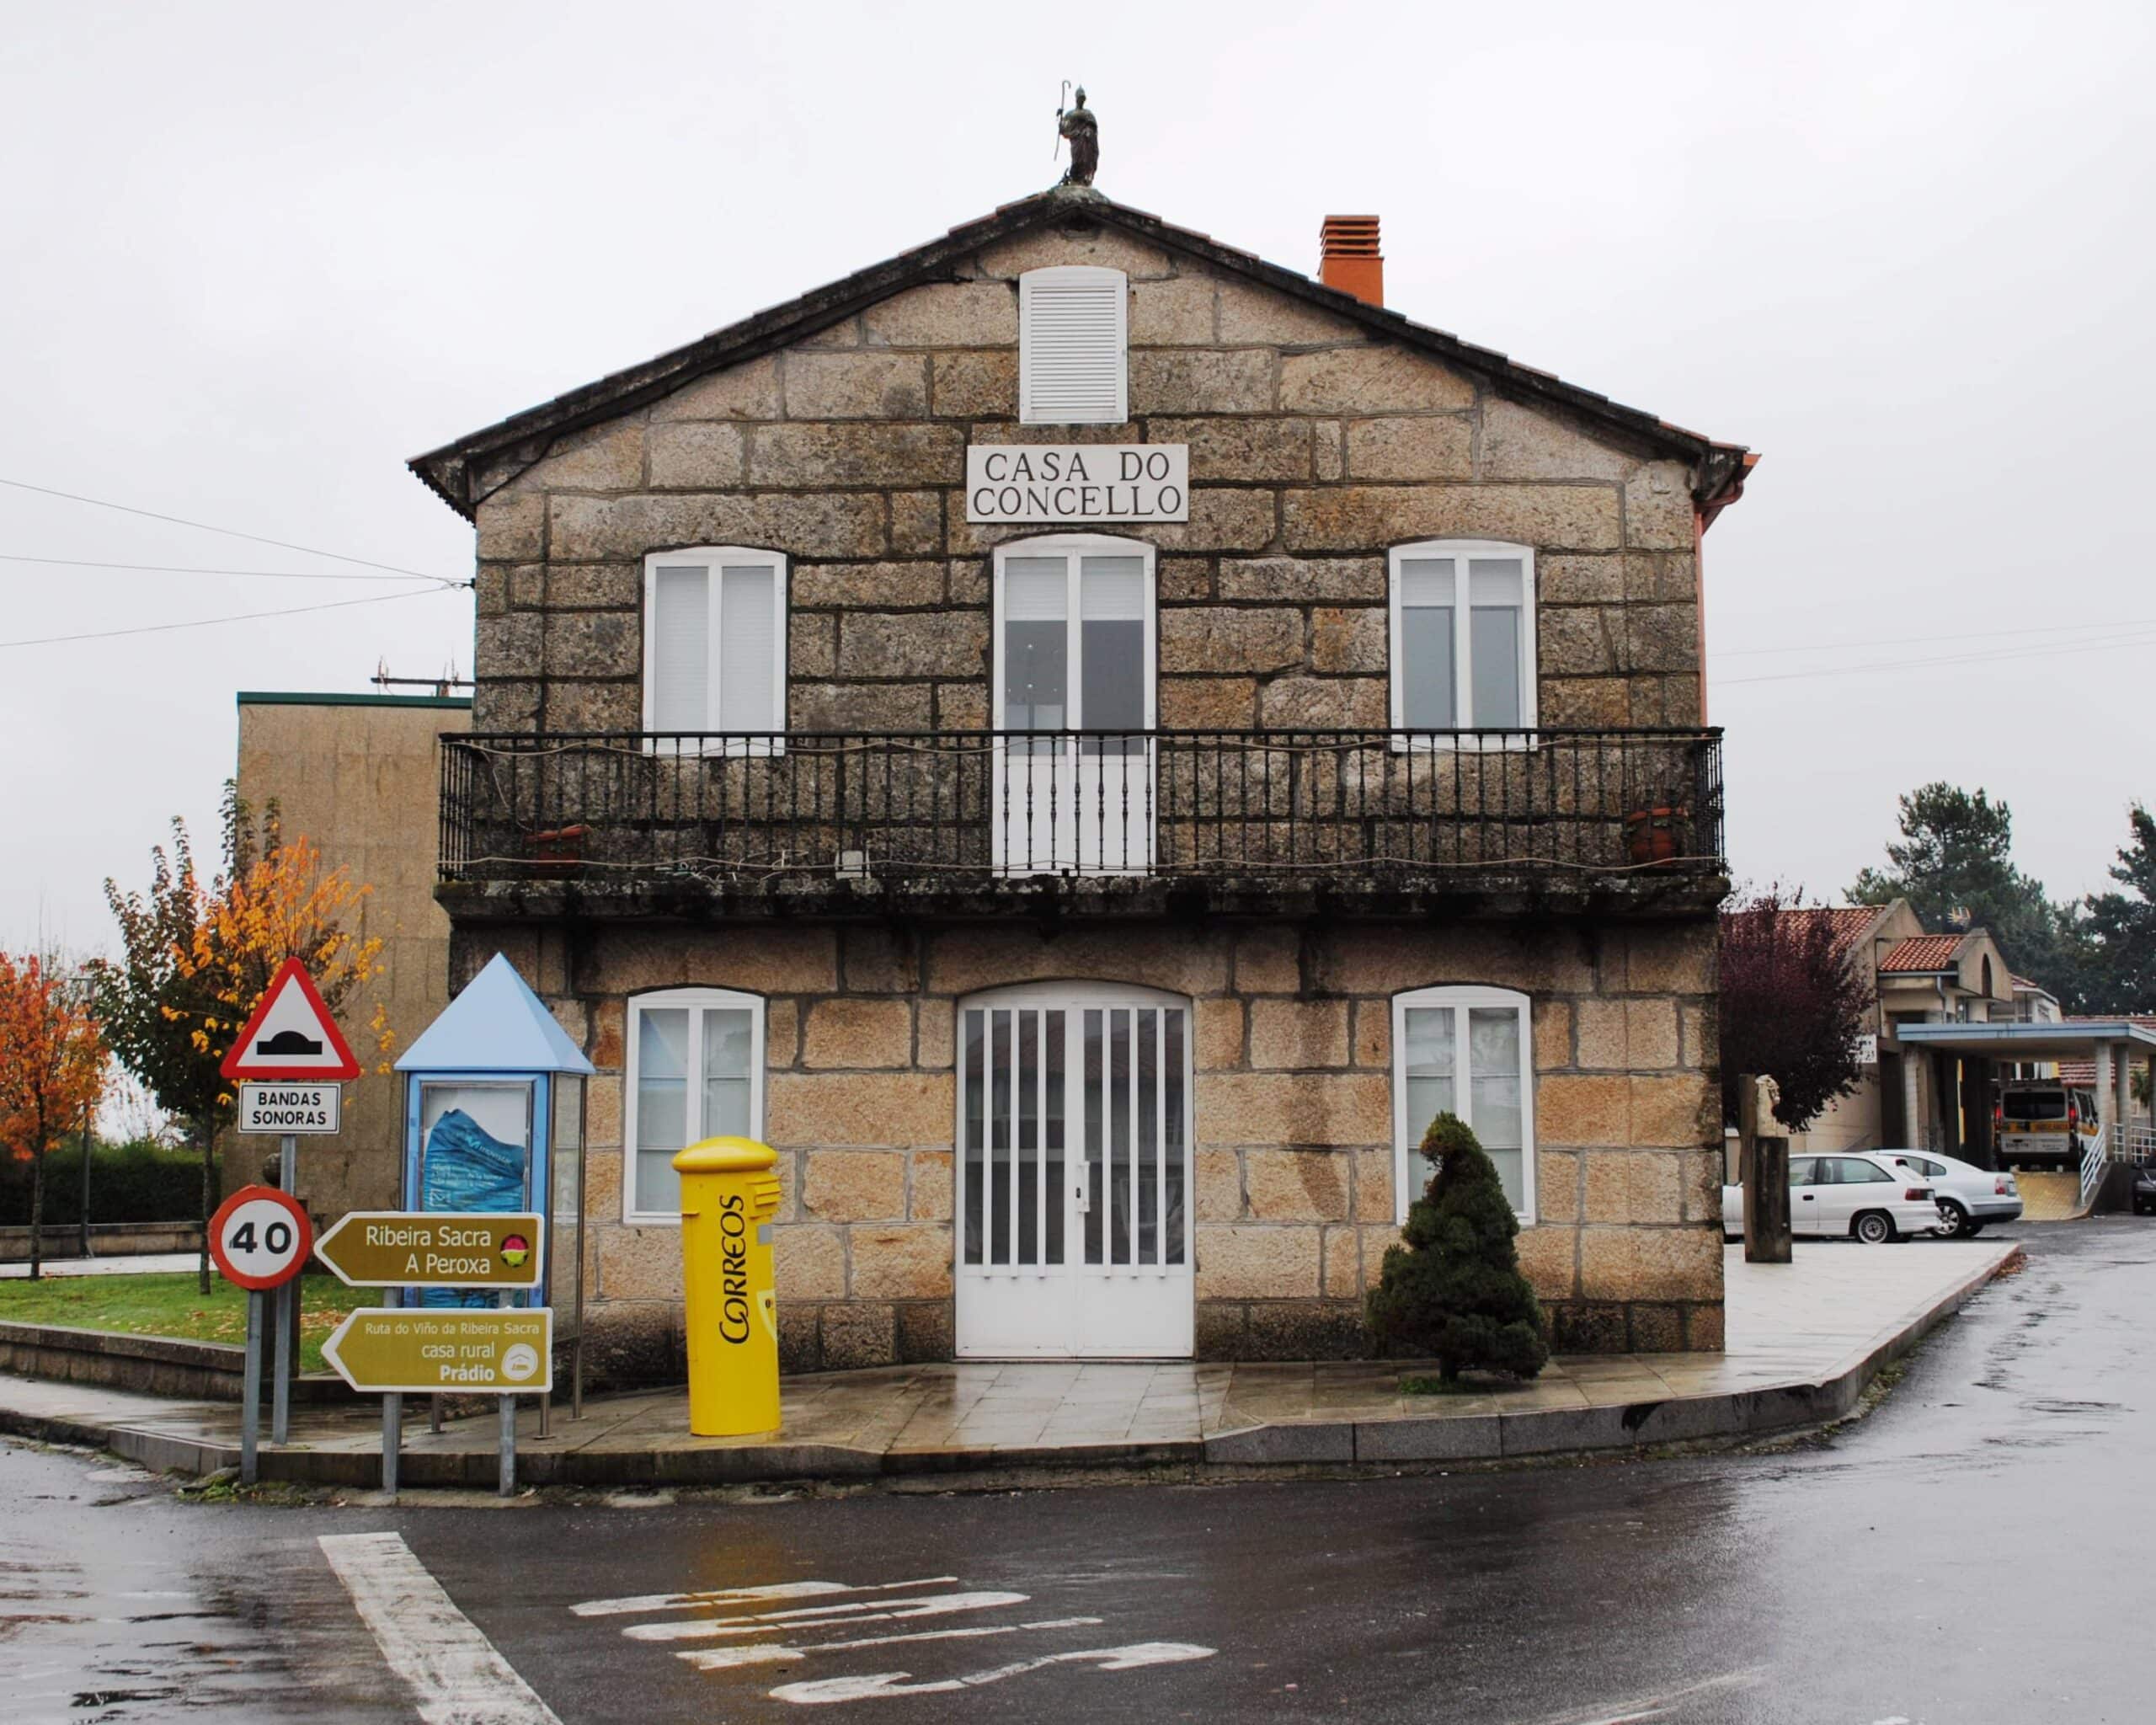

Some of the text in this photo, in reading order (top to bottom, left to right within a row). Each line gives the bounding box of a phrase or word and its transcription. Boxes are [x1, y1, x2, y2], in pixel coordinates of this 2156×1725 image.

[985, 451, 1170, 482] CASA DO
[973, 485, 1182, 515] CONCELLO
[258, 1092, 321, 1106] BANDAS
[252, 1111, 326, 1124] SONORAS
[230, 1221, 291, 1254] 40
[366, 1226, 491, 1247] Ribeira Sacra
[405, 1253, 491, 1274] A Peroxa
[719, 1194, 750, 1344] CORREOS
[365, 1322, 540, 1335] Ruta do Viño da Ribeira Sacra
[421, 1341, 495, 1359] casa rural
[440, 1363, 495, 1382] Prádio
